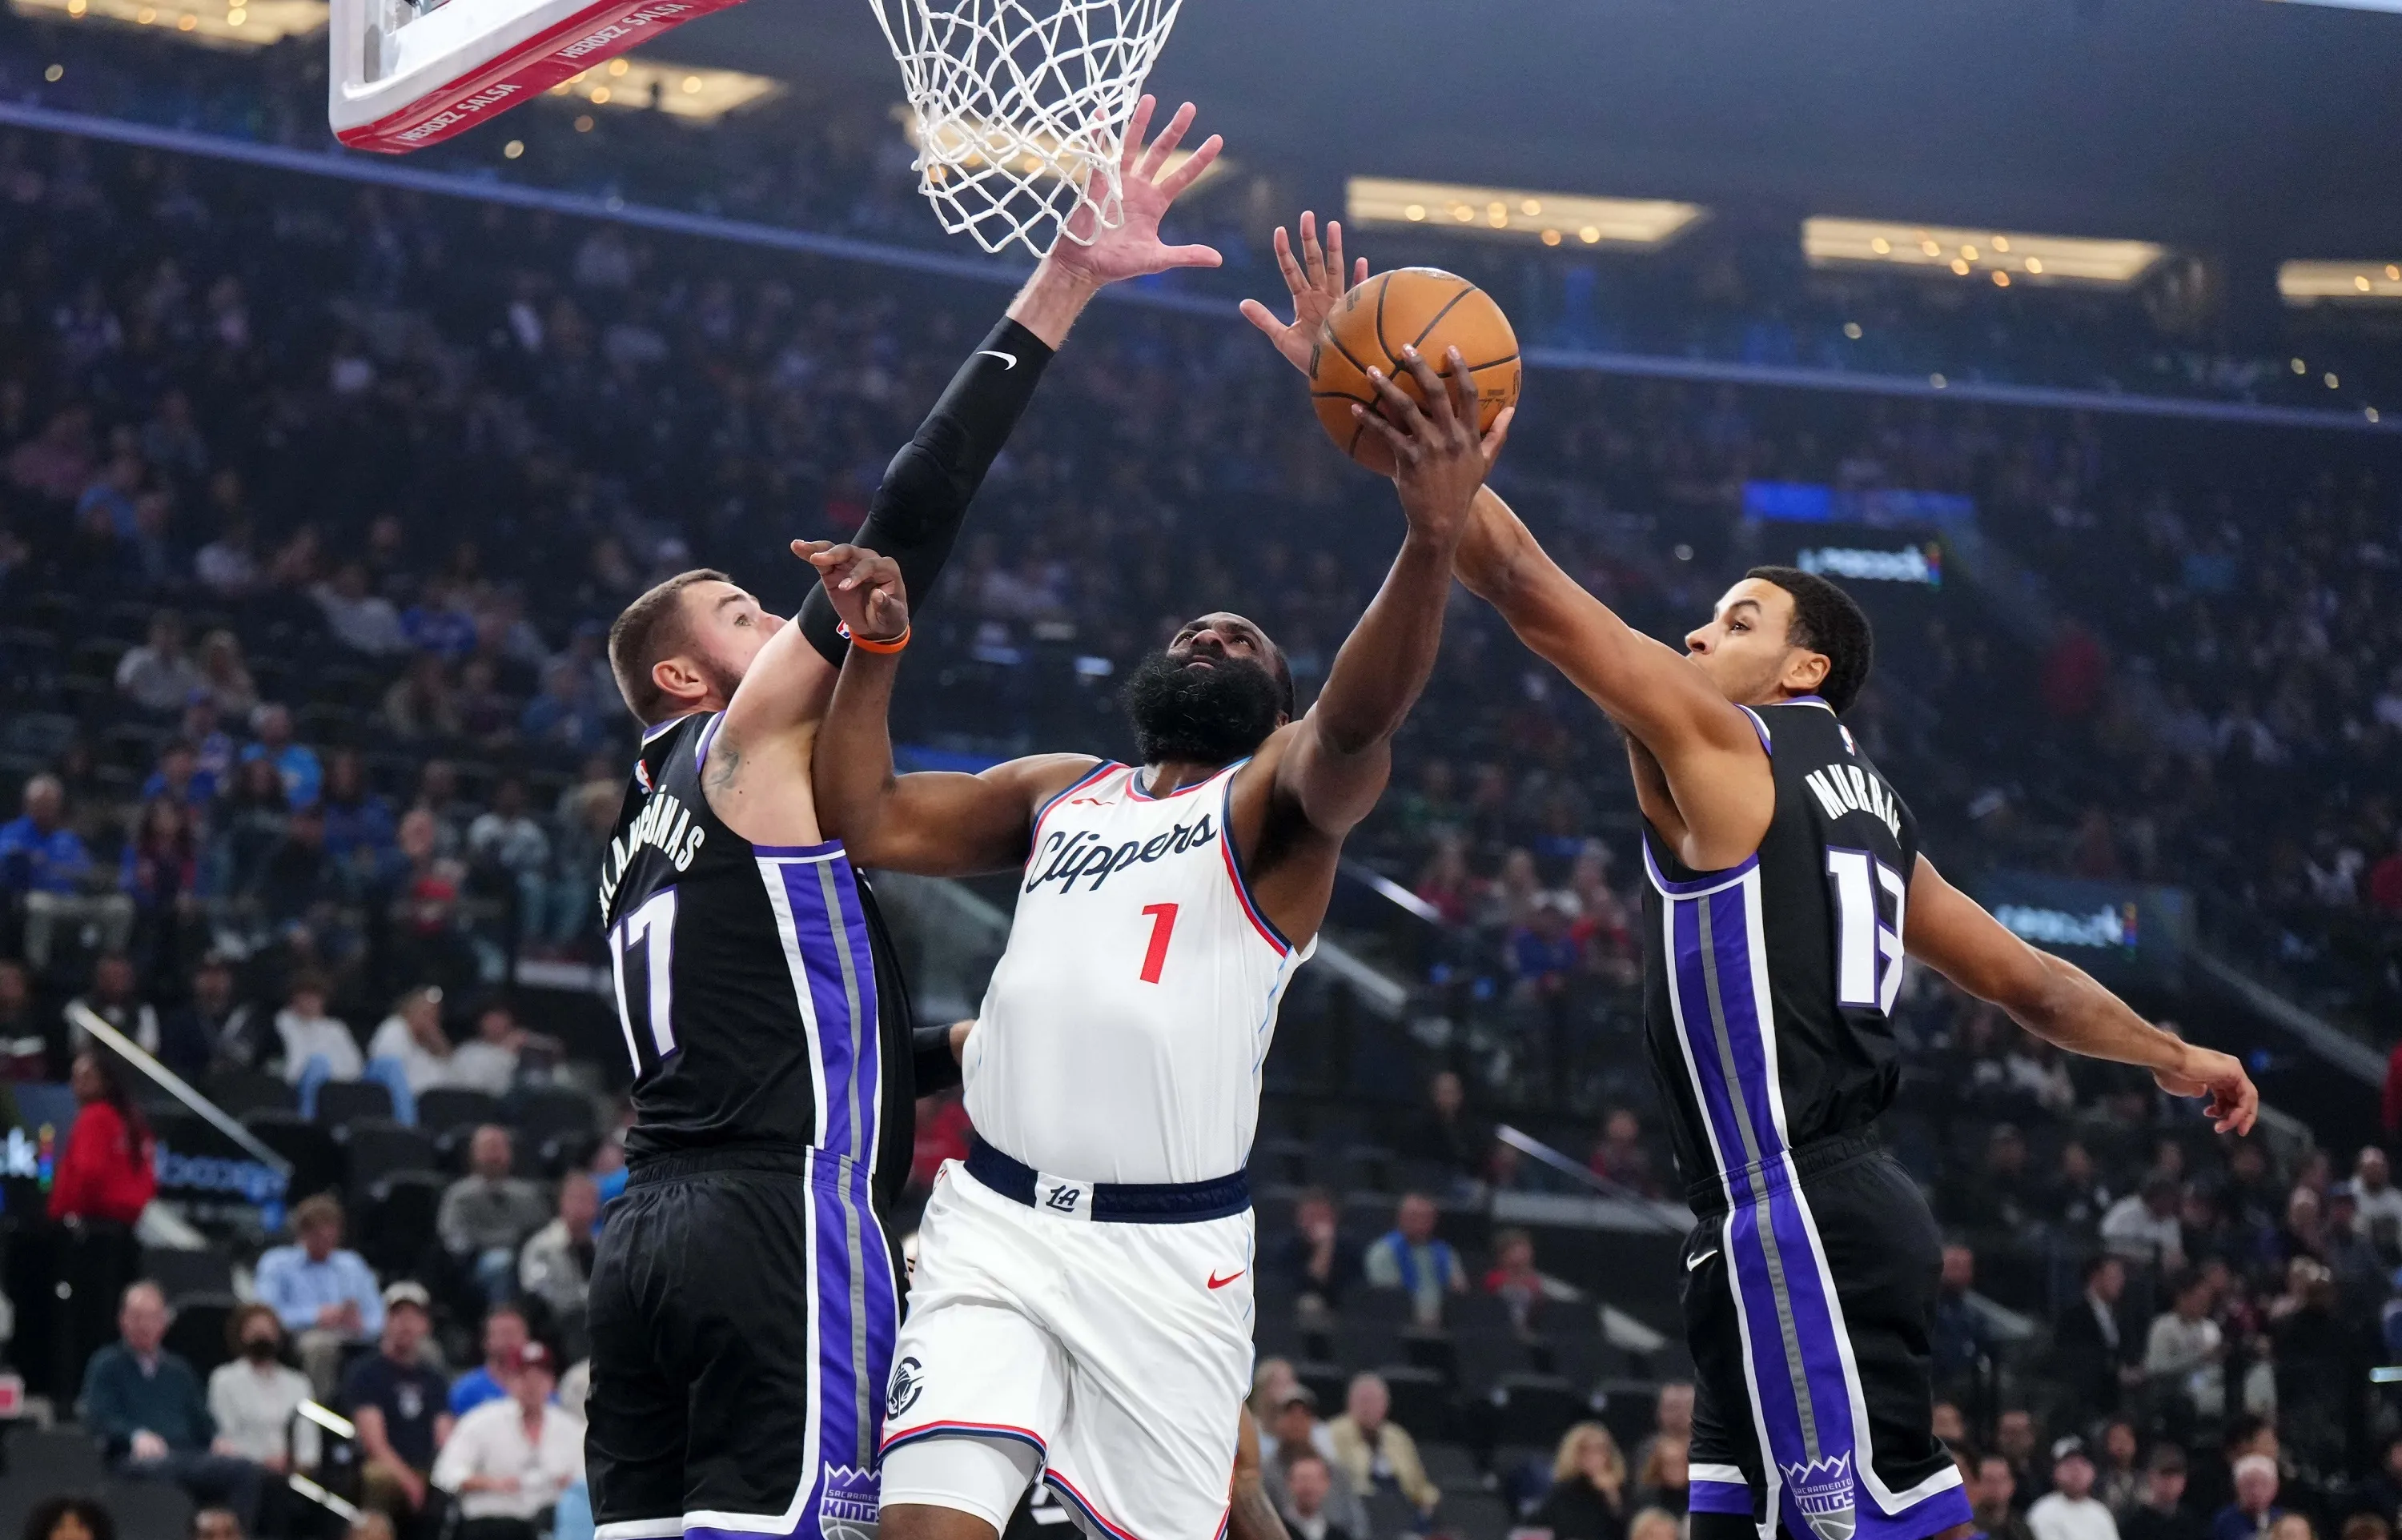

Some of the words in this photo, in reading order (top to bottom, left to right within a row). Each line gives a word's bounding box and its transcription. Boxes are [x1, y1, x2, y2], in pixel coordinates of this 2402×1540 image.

[556, 25, 631, 58] HERDEZ
[621, 3, 694, 26] SALSA
[396, 110, 467, 142] HERDEZ
[456, 83, 522, 111] SALSA
[1026, 812, 1218, 895] Clippers
[1140, 902, 1179, 985] 1
[828, 1488, 880, 1502] SACRAMEN
[1793, 1478, 1853, 1495] SACRAMENTO
[1796, 1489, 1854, 1514] KINGS
[822, 1498, 880, 1523] KING
